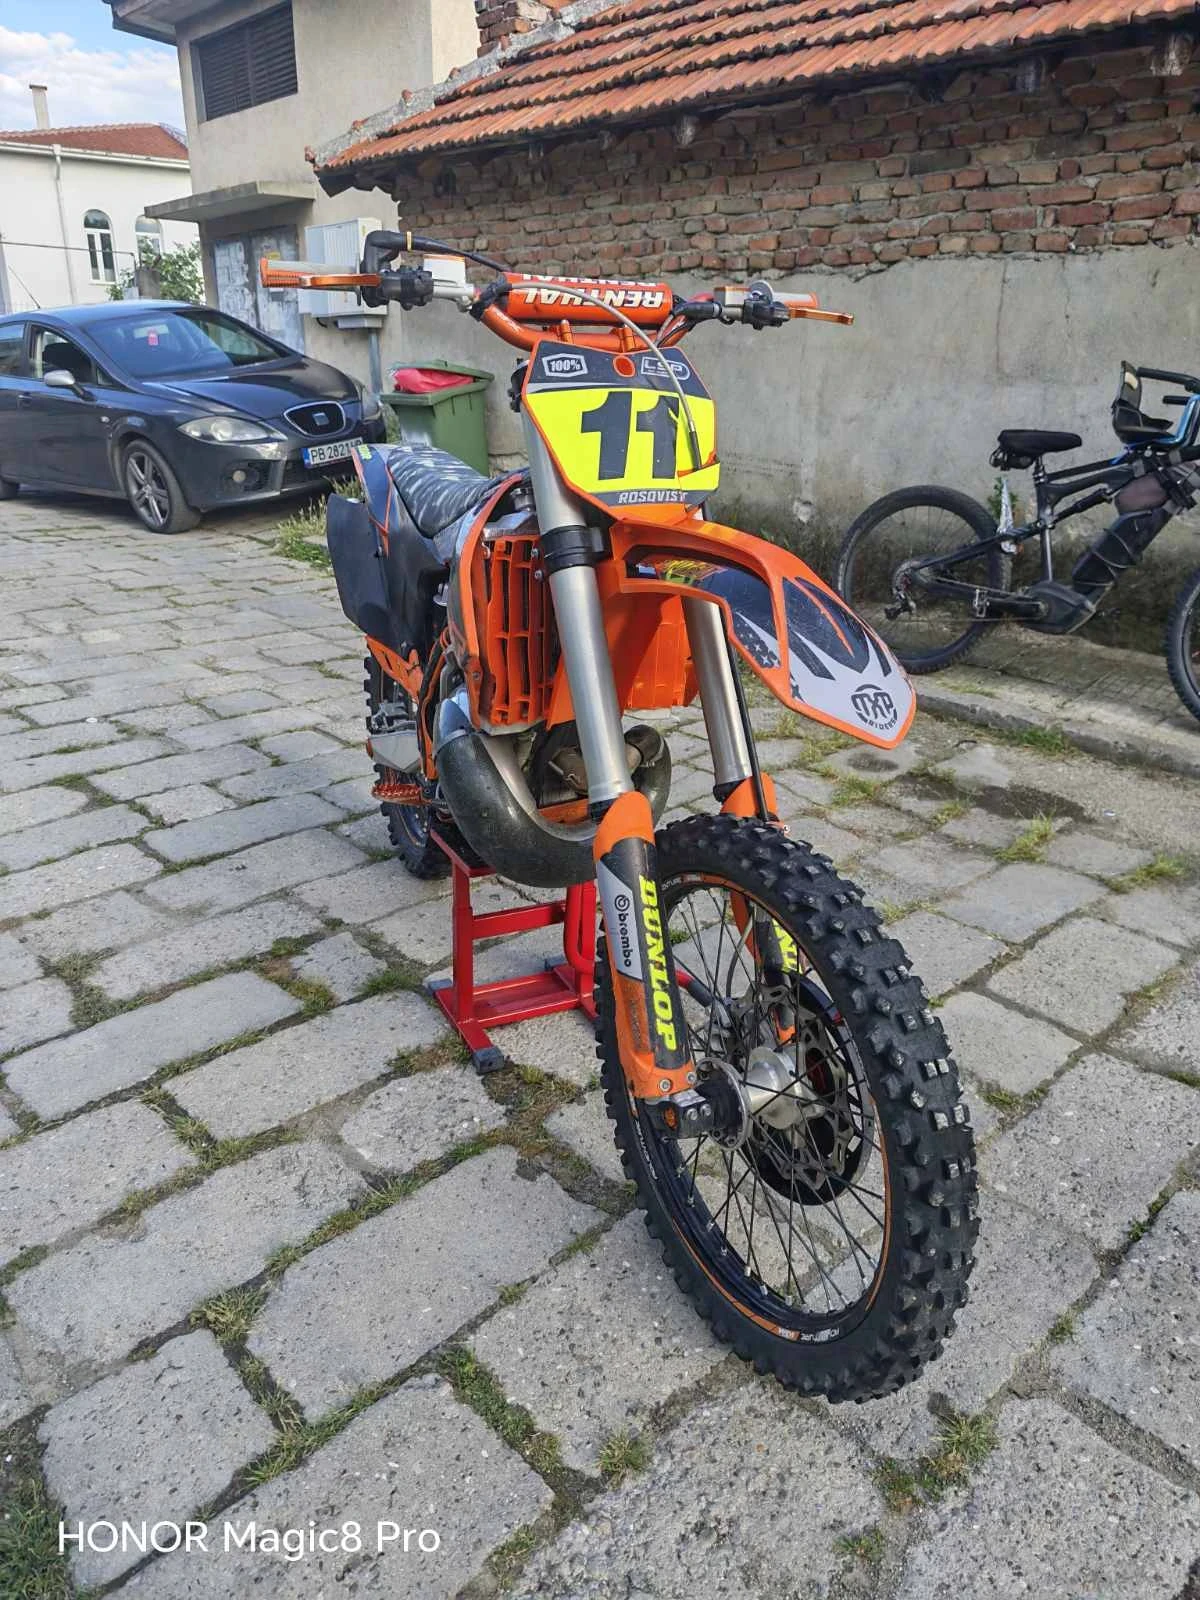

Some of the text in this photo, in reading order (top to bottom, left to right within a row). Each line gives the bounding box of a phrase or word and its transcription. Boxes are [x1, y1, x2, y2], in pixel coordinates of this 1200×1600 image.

[518, 287, 664, 309] RENTHAL
[550, 359, 581, 372] 100%
[580, 390, 680, 481] 11
[617, 912, 633, 968] brembo
[639, 875, 677, 1051] DUNLOP
